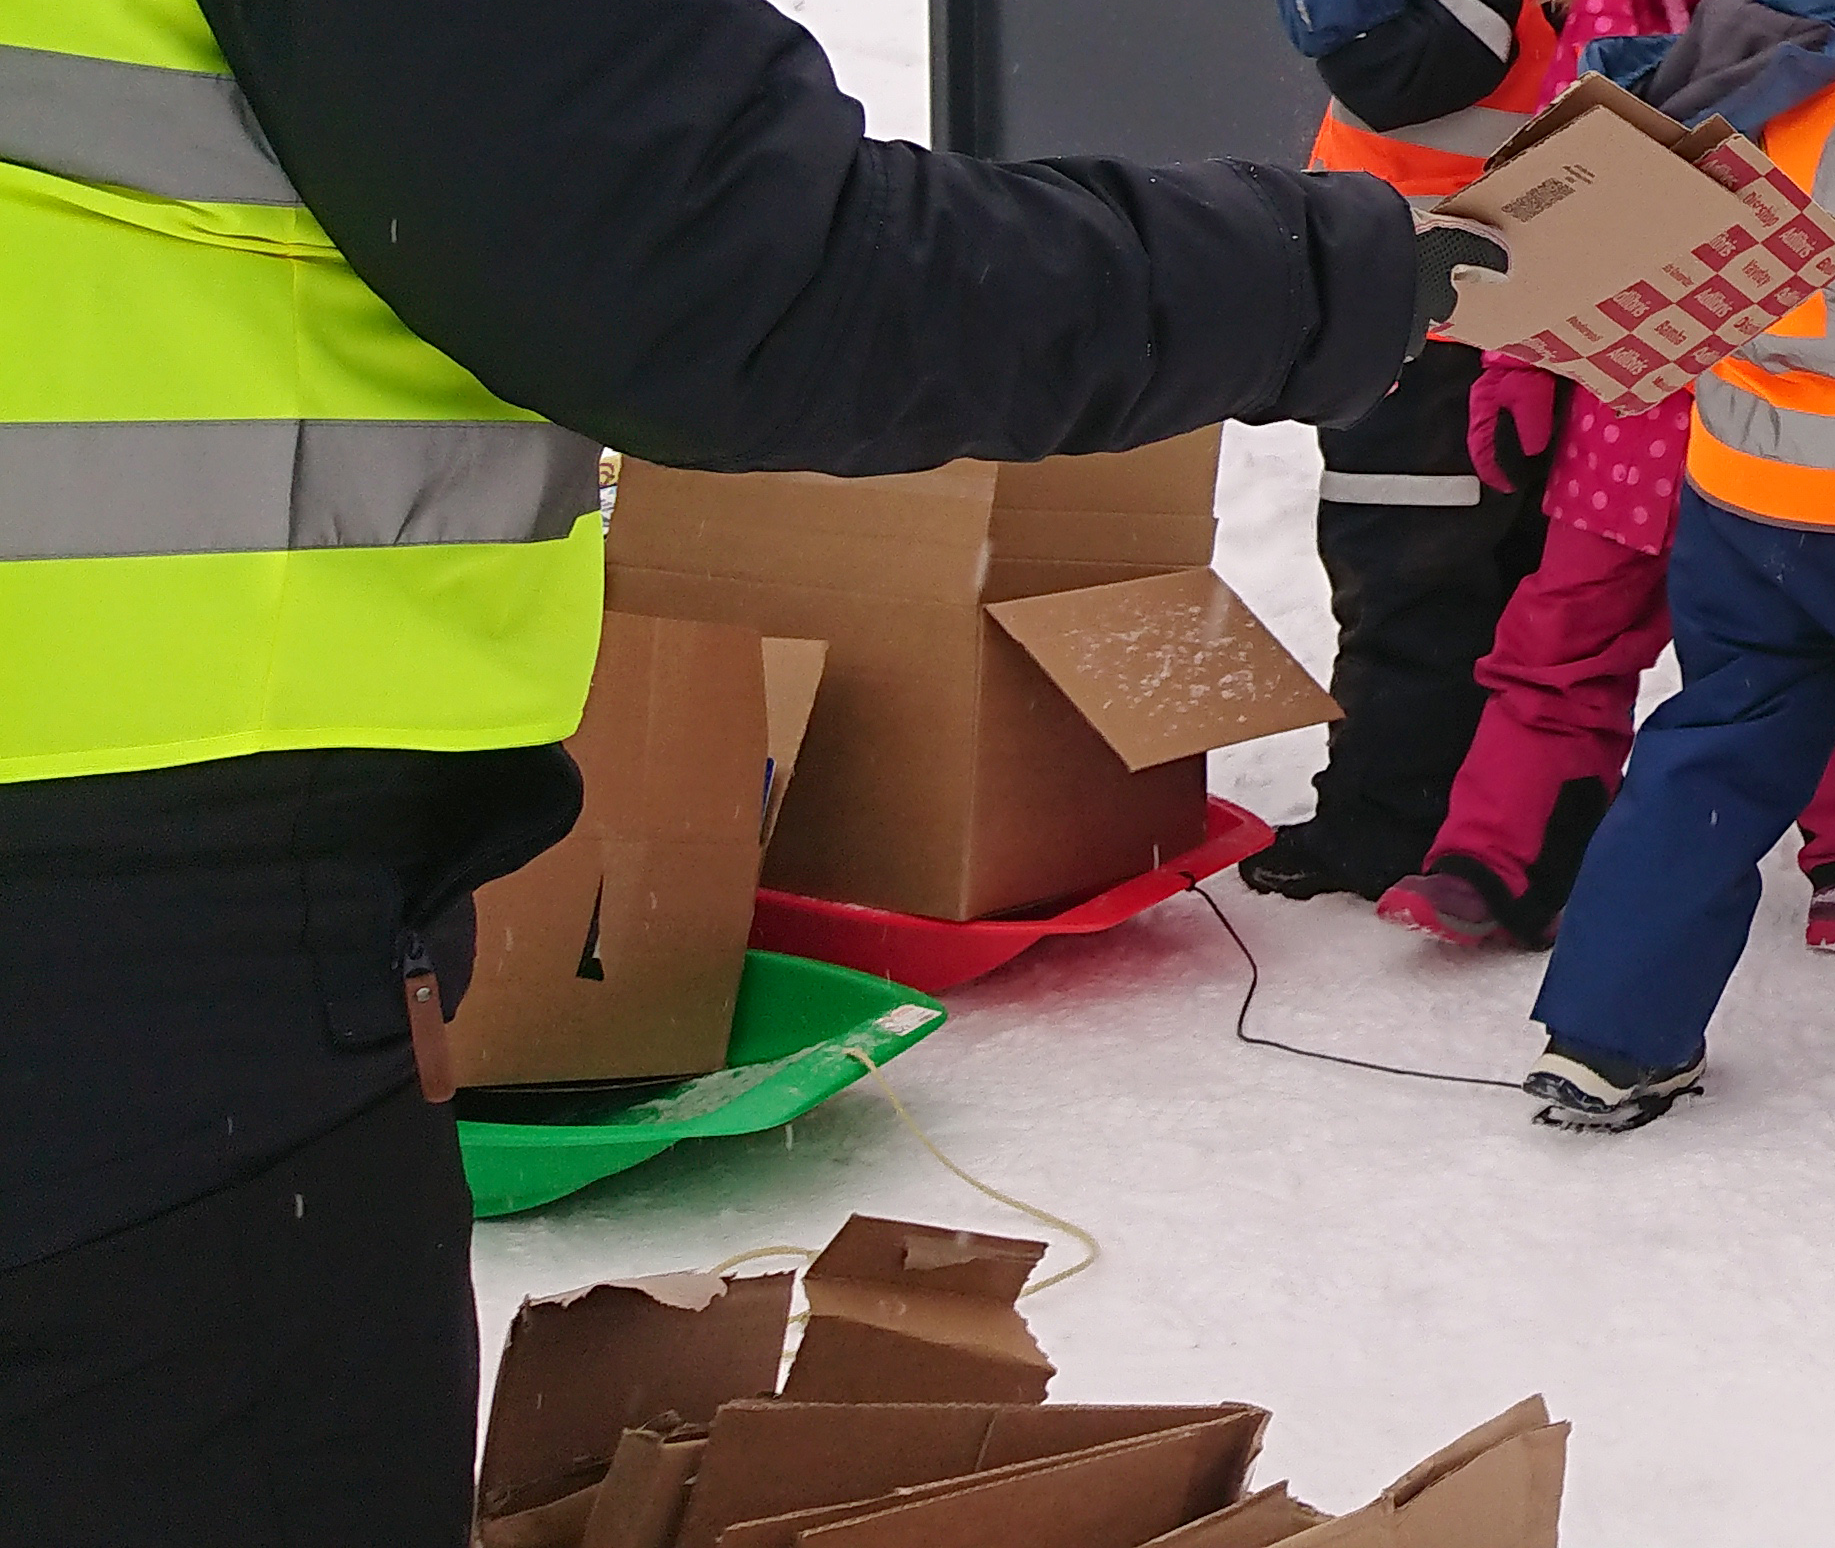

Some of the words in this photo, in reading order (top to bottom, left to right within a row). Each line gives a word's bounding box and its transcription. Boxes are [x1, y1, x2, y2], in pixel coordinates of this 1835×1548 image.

[1778, 227, 1818, 259] Adlibris
[1693, 287, 1734, 319] Adlibris
[1606, 347, 1649, 377] Adlibris
